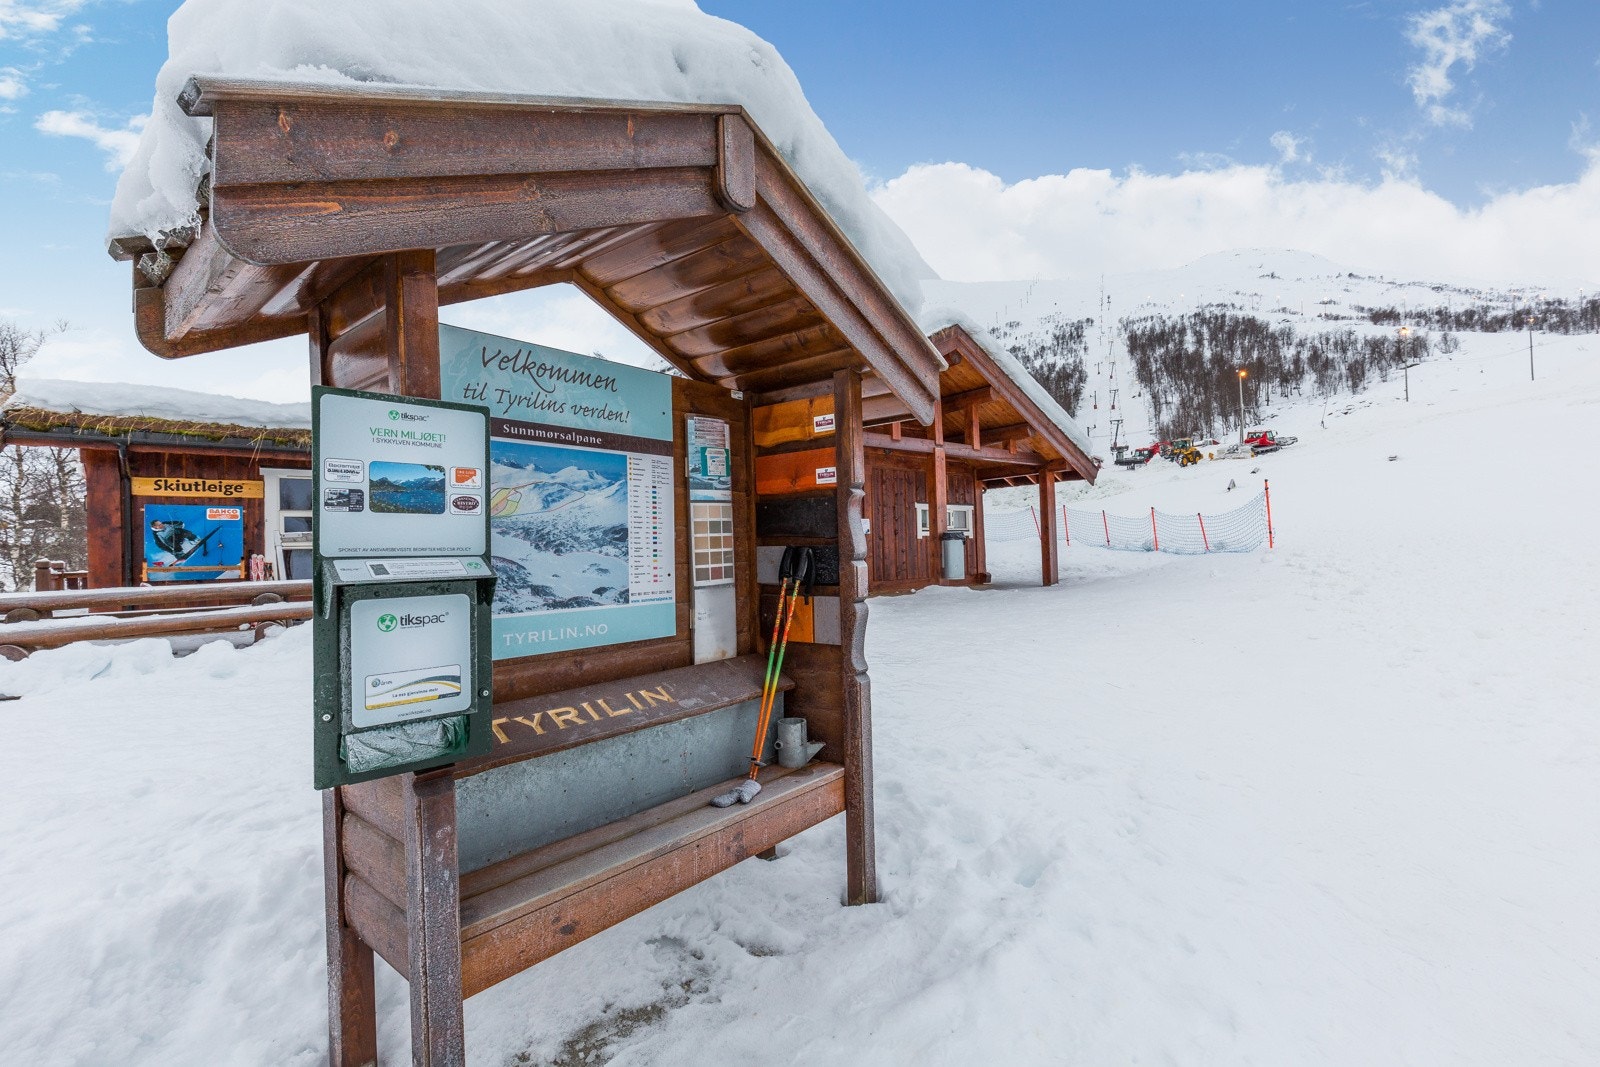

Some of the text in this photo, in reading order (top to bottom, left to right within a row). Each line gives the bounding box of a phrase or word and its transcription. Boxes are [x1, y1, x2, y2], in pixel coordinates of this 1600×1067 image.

[482, 346, 618, 393] Velkommen
[463, 382, 631, 424] til Tyrilins verden!
[400, 412, 427, 422] tikspac
[369, 426, 446, 443] VERN MILJØET!
[376, 437, 411, 446] SYKKYLVEN
[411, 441, 442, 449] KOMMUNE
[503, 423, 602, 444] Sunnmørsalpane
[153, 479, 244, 496] Skiutleige
[400, 613, 446, 628] tikspac
[502, 623, 608, 646] TYRILIN.NO
[491, 685, 676, 744] TYRILIN
